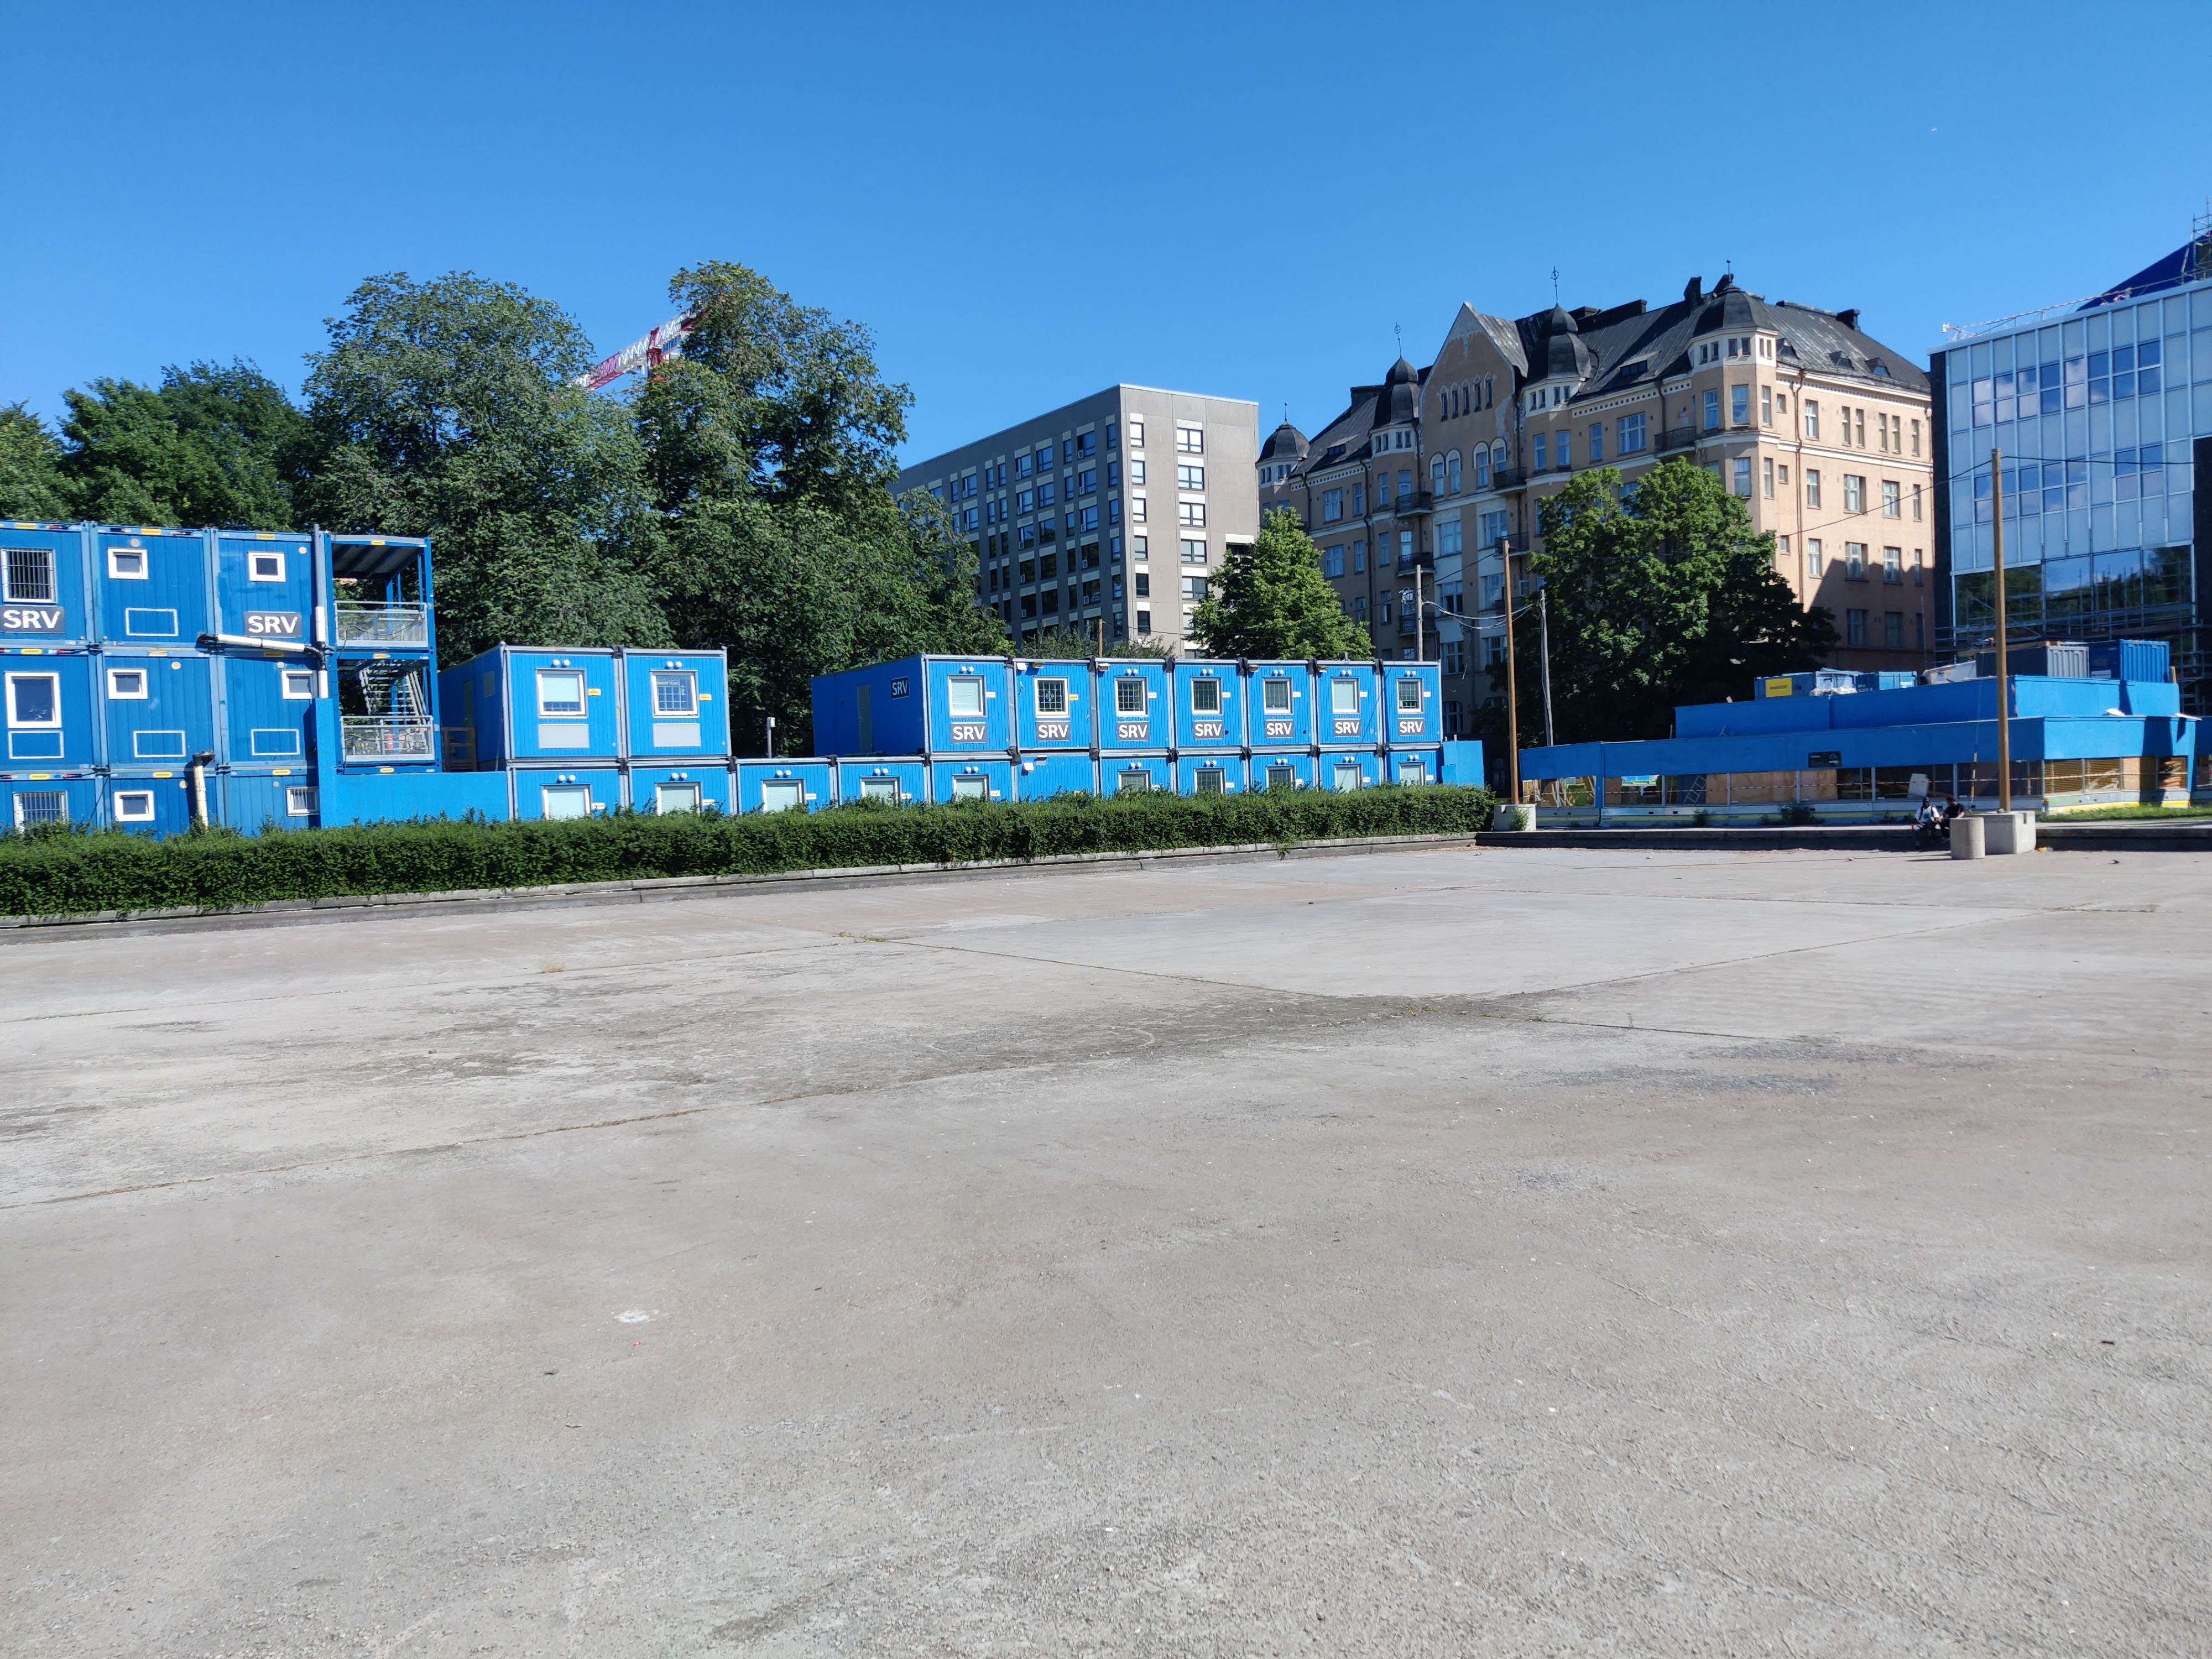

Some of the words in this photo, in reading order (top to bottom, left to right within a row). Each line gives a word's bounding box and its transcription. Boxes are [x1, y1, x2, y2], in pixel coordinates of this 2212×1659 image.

[3, 609, 61, 629] SRV
[248, 615, 298, 633] SRV
[892, 680, 908, 696] SRV
[953, 726, 985, 740] SRV
[1038, 724, 1068, 738] SRV
[1119, 724, 1147, 738] SRV
[1194, 723, 1222, 737] SRV
[1266, 722, 1292, 735] SRV
[1335, 721, 1360, 734] SRV
[1400, 721, 1423, 733] SRV
